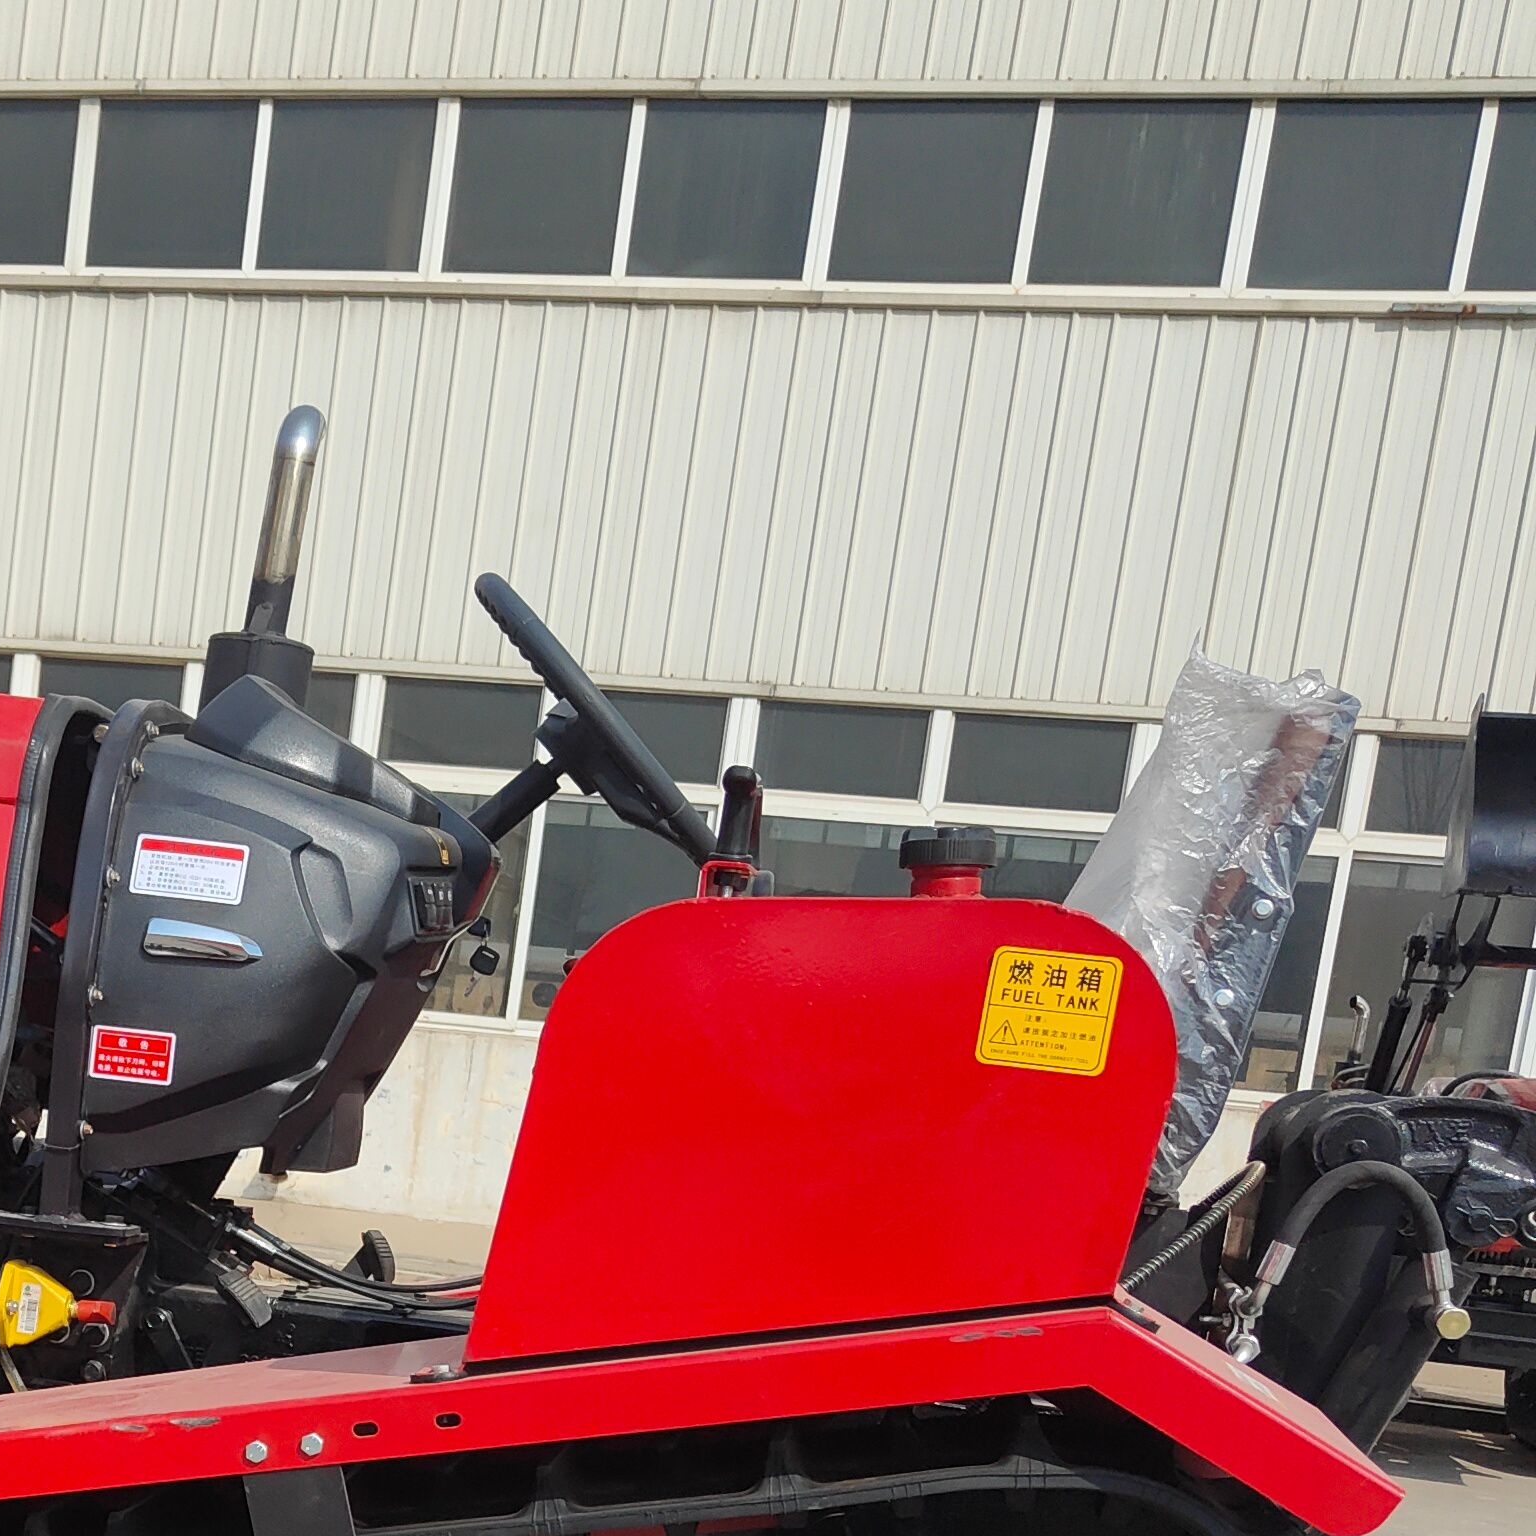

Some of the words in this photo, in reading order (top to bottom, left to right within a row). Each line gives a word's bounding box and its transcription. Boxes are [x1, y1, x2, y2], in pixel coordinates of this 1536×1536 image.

[1007, 958, 1104, 993] 燃油箱
[1001, 988, 1044, 1006] FUEL
[1056, 994, 1100, 1011] TANK
